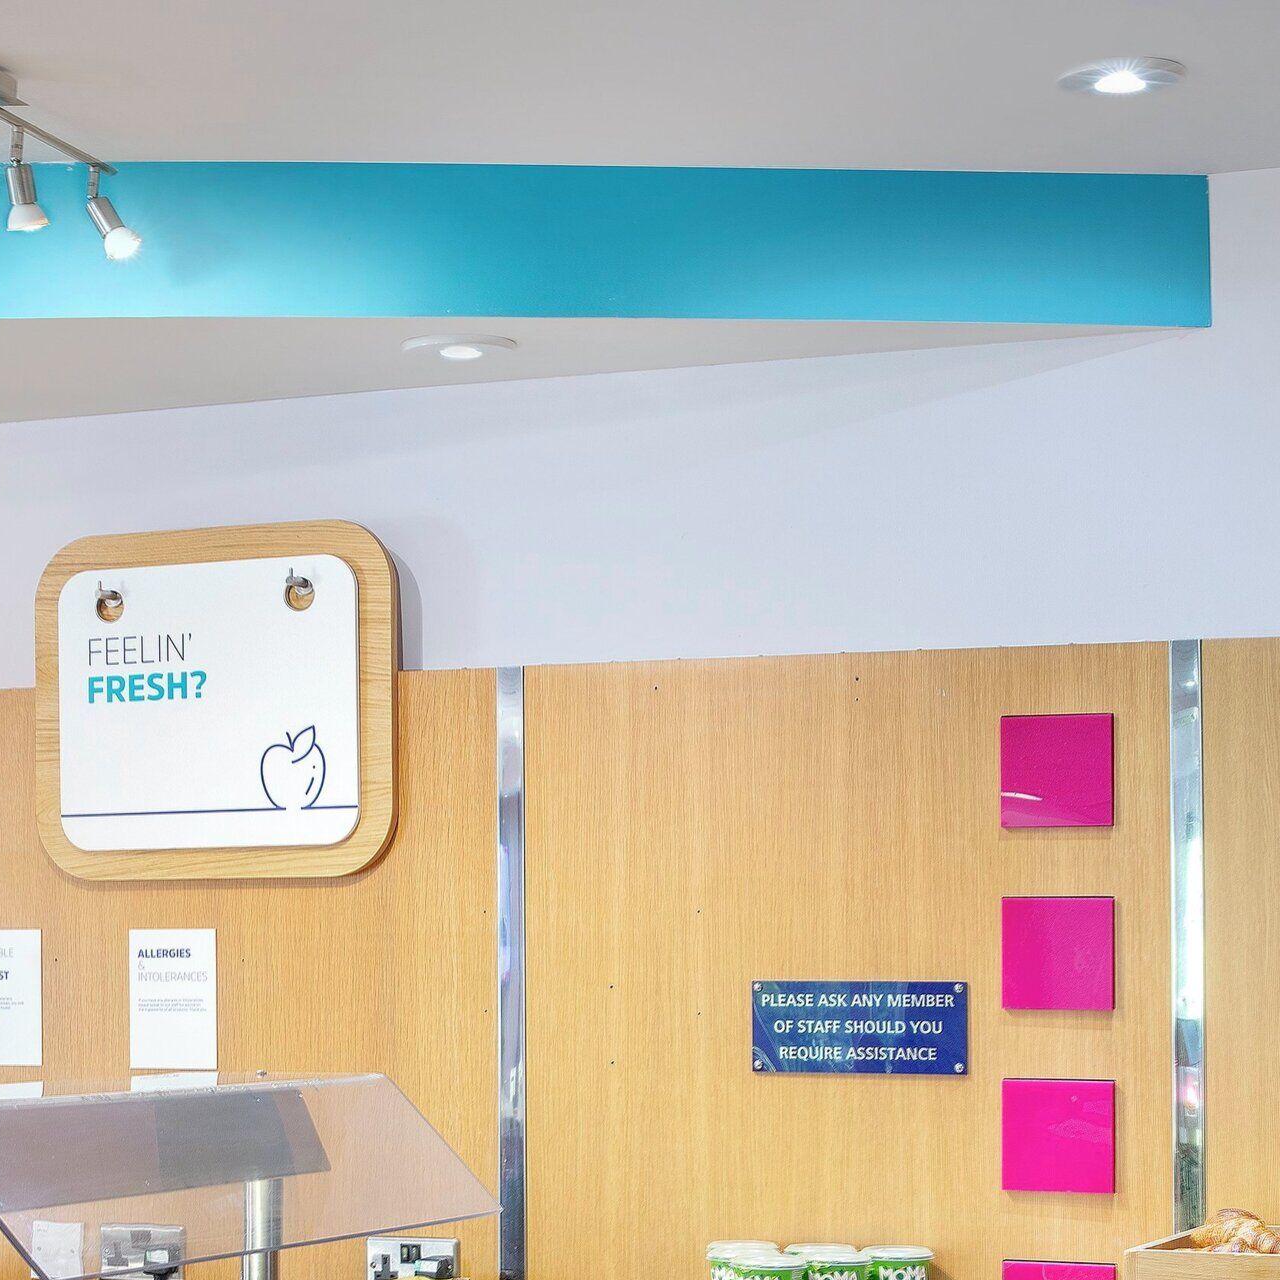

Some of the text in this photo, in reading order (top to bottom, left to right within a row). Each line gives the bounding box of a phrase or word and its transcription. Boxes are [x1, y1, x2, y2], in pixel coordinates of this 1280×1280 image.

[88, 670, 207, 704] FRESH?
[137, 948, 192, 959] ALLERGIES
[138, 971, 208, 982] INTOLERANCES
[761, 993, 955, 1008] PLEASE ASK ANY MEMBER
[773, 1020, 943, 1034] OF STAFF SHOULD YOU
[779, 1046, 937, 1061] REQUIRE ASSISTANCE
